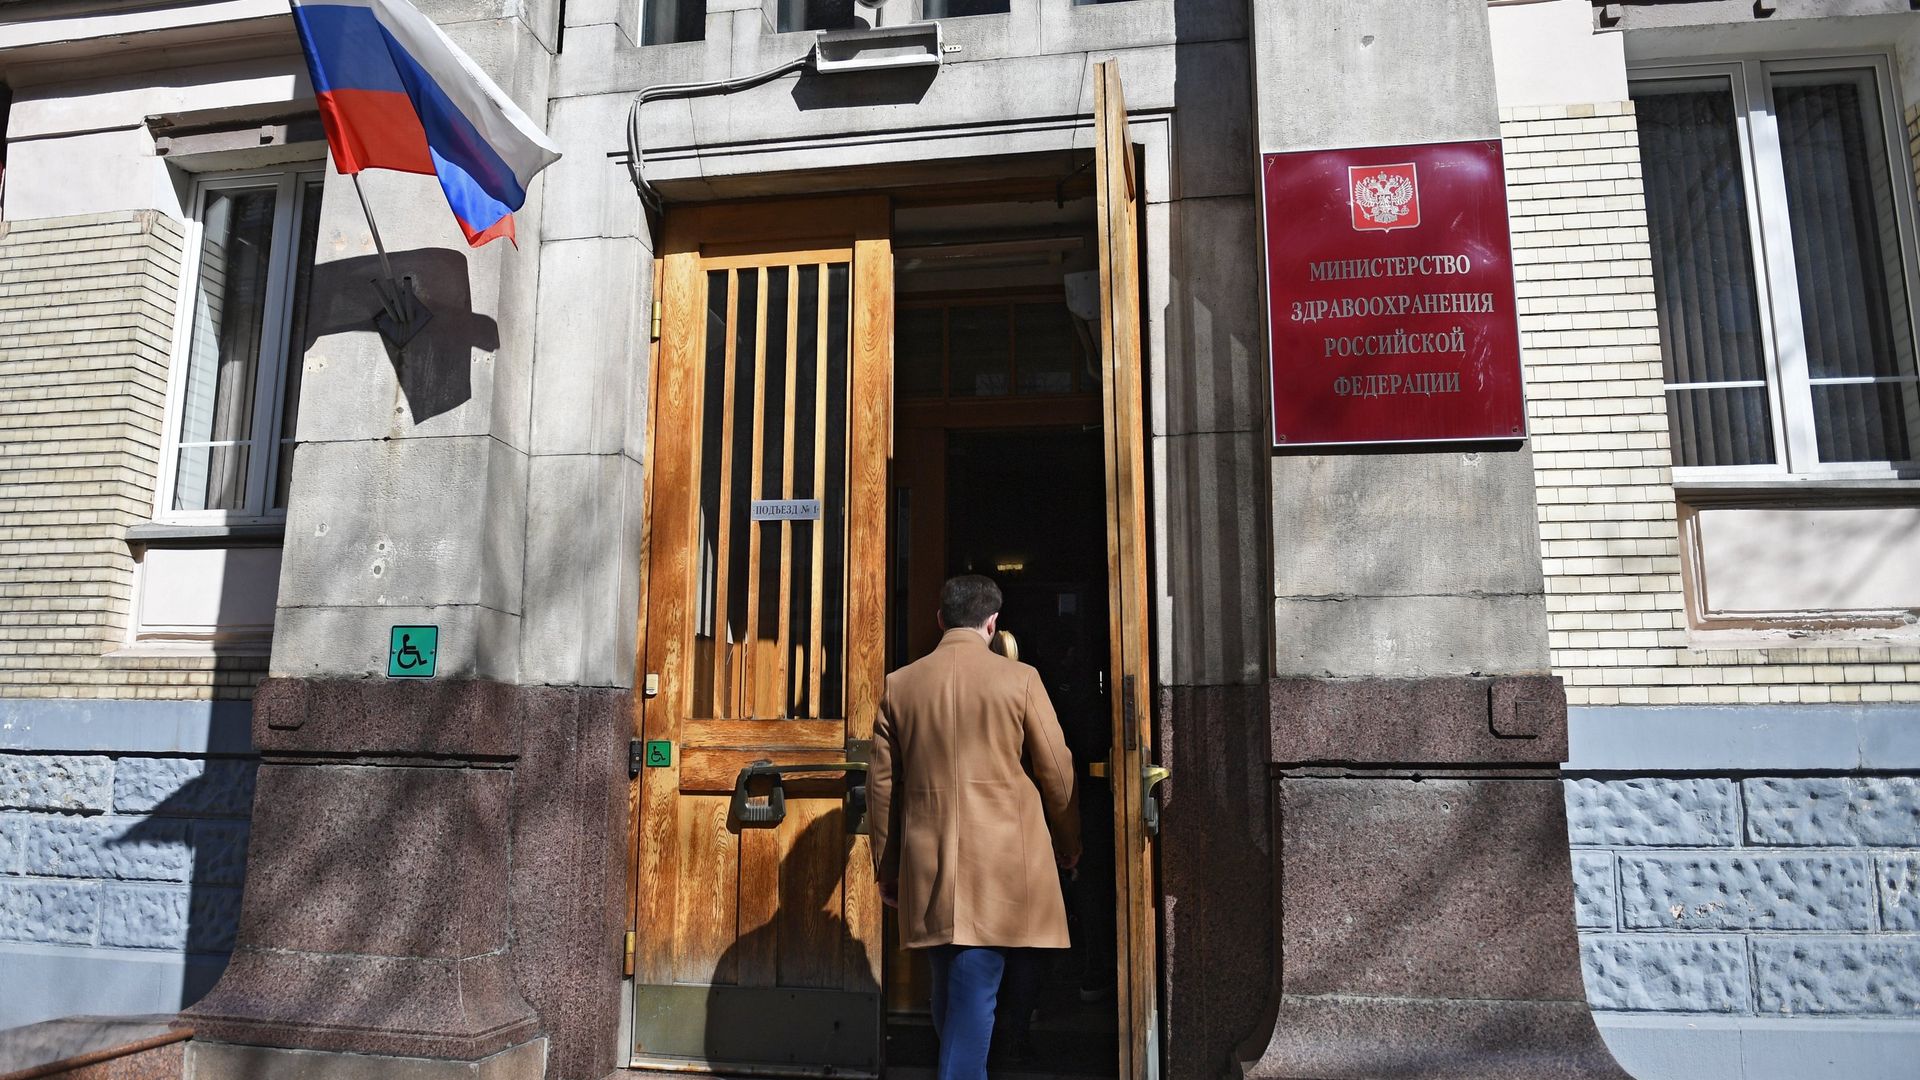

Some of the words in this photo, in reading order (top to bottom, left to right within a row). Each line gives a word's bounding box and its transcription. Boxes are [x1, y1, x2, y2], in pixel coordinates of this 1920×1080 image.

[1309, 254, 1471, 281] МИНИСТЕРСТВО
[1290, 293, 1494, 324] ЗДРАВООХРАНЕНИЯ
[1324, 326, 1466, 357] РОССИЙСКОЙ
[1333, 372, 1461, 399] ФЕДЕРАЦИИ
[755, 505, 798, 515] ПОДЪЕЗД
